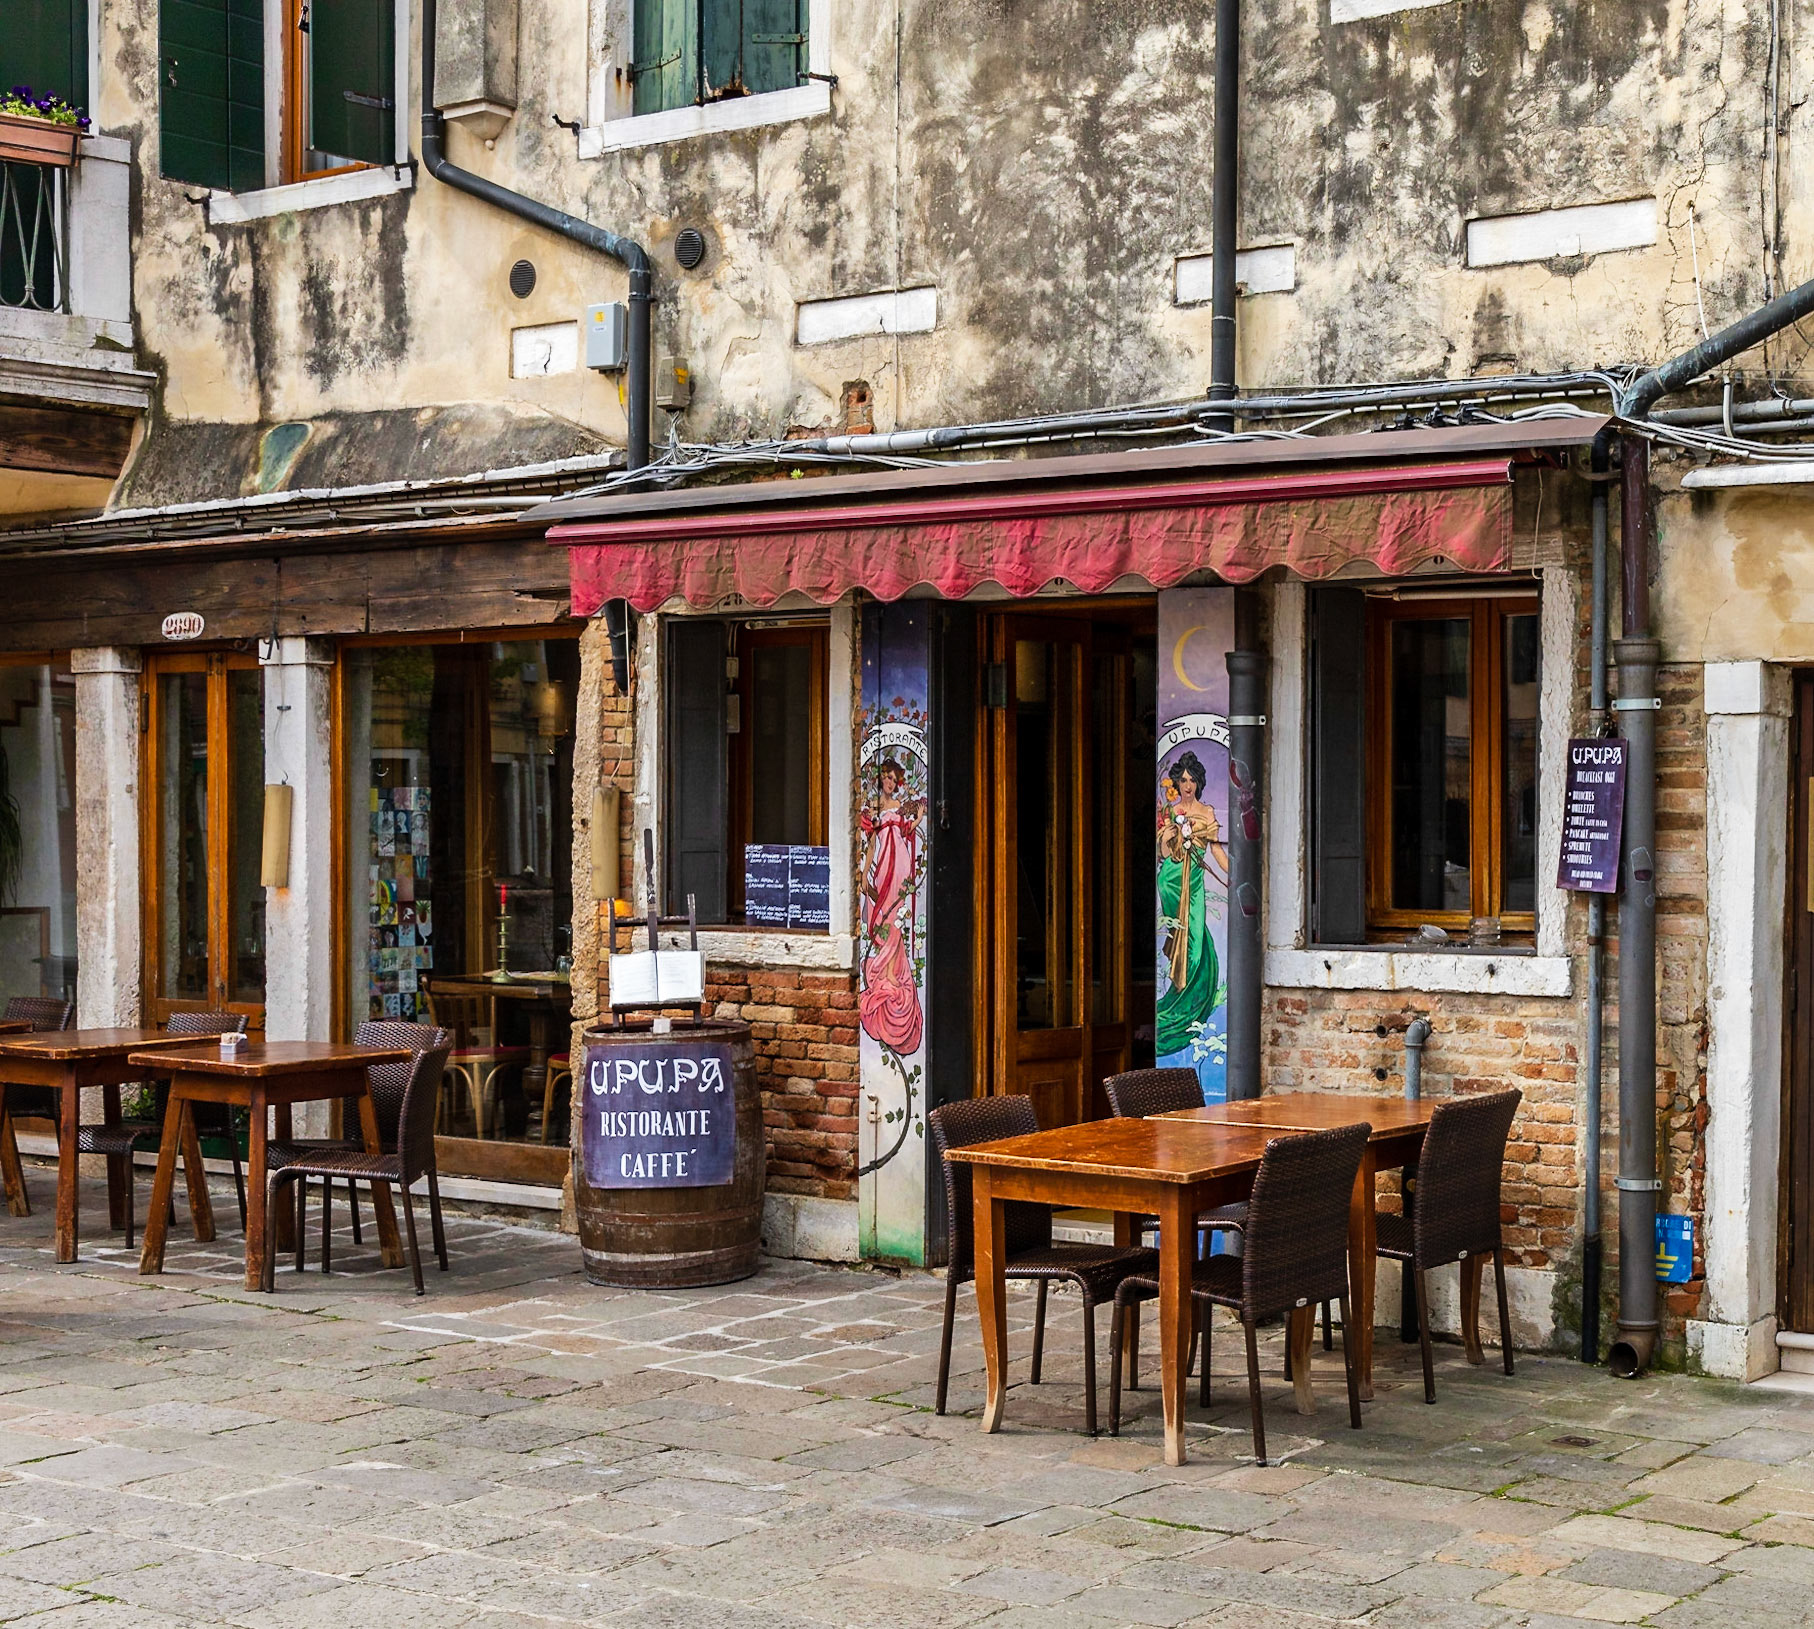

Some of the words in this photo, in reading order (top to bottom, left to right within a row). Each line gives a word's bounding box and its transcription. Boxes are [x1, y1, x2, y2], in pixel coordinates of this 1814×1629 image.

[723, 592, 746, 607] 28
[166, 616, 201, 635] 2890
[862, 732, 927, 758] RISTORANTE
[1572, 747, 1623, 765] UPUPA
[1566, 853, 1593, 865] SMOOTHIES
[590, 1057, 725, 1096] UPUPA
[600, 1109, 711, 1138] RISTORANTE
